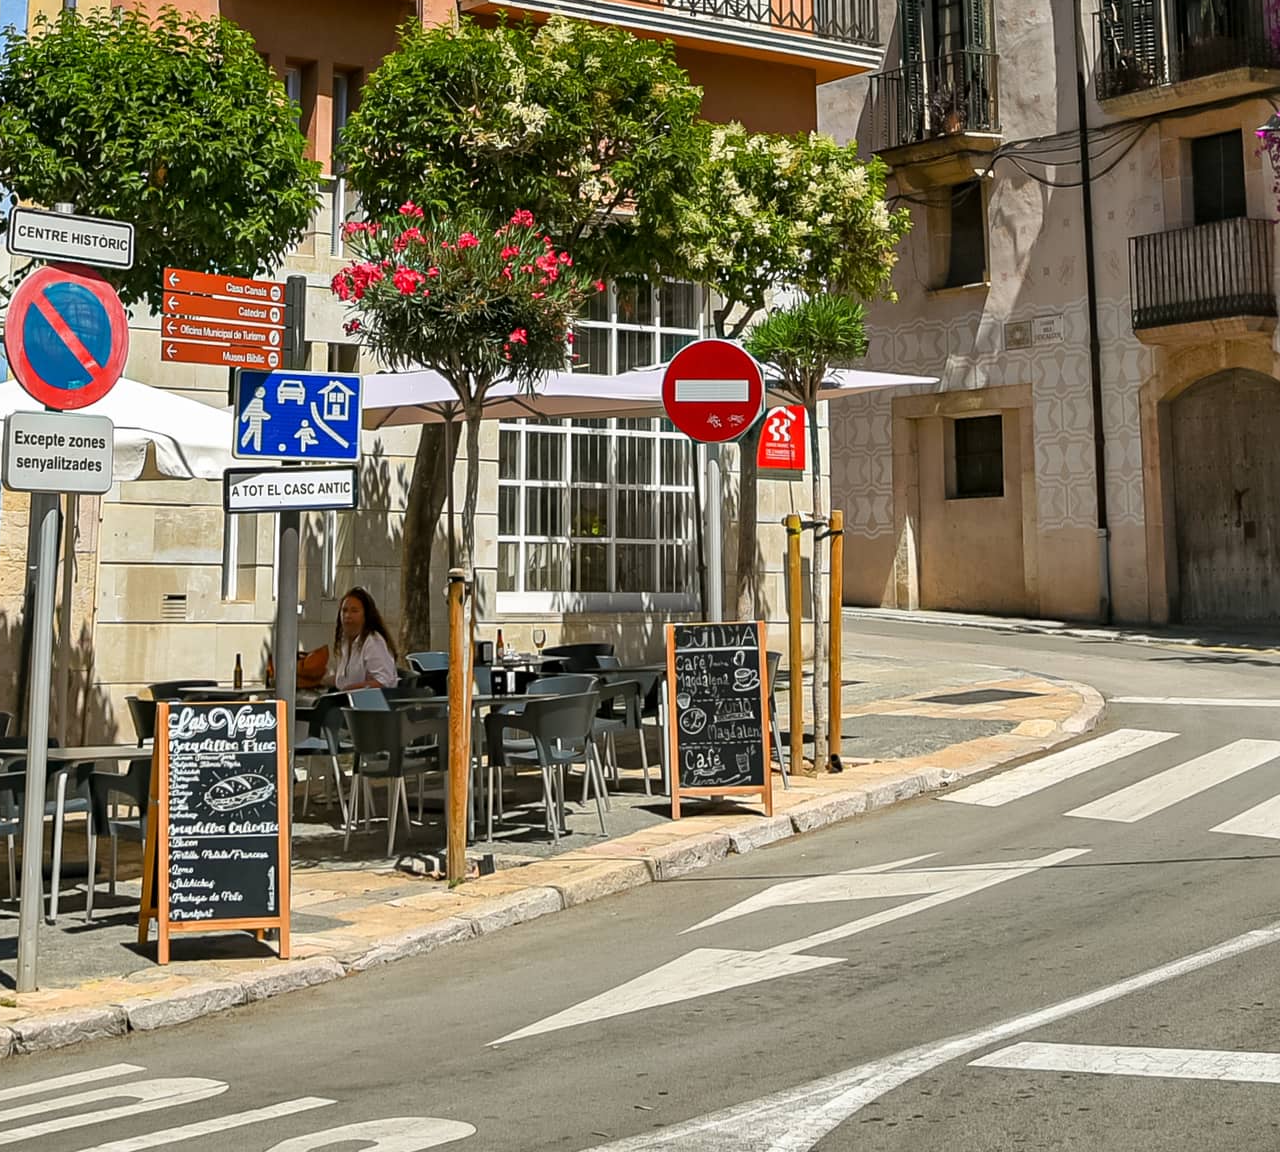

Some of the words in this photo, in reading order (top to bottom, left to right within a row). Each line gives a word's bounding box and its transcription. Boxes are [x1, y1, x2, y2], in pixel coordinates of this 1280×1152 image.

[18, 225, 70, 244] CENTRE
[71, 228, 128, 252] HISTÒRIC
[226, 283, 244, 294] Casa
[239, 307, 267, 319] Catedral
[180, 324, 202, 336] Oficina
[203, 327, 233, 340] Municipal
[234, 330, 242, 340] de
[243, 331, 266, 342] Turisme
[223, 351, 246, 362] Museu
[15, 430, 66, 451] Excepte
[69, 436, 106, 450] zones
[16, 454, 103, 474] senyalitzades
[232, 484, 241, 497] A
[243, 484, 266, 497] TOT
[267, 483, 281, 496] EL
[283, 482, 316, 496] CASC
[317, 480, 351, 496] ANTIC
[675, 655, 707, 671] Café
[168, 707, 209, 739] Las
[208, 705, 277, 738] Vegas
[707, 721, 762, 741] Magdalen
[685, 747, 722, 770] Café
[172, 838, 198, 848] Bacon
[172, 864, 194, 875] Lomo
[209, 892, 220, 902] de
